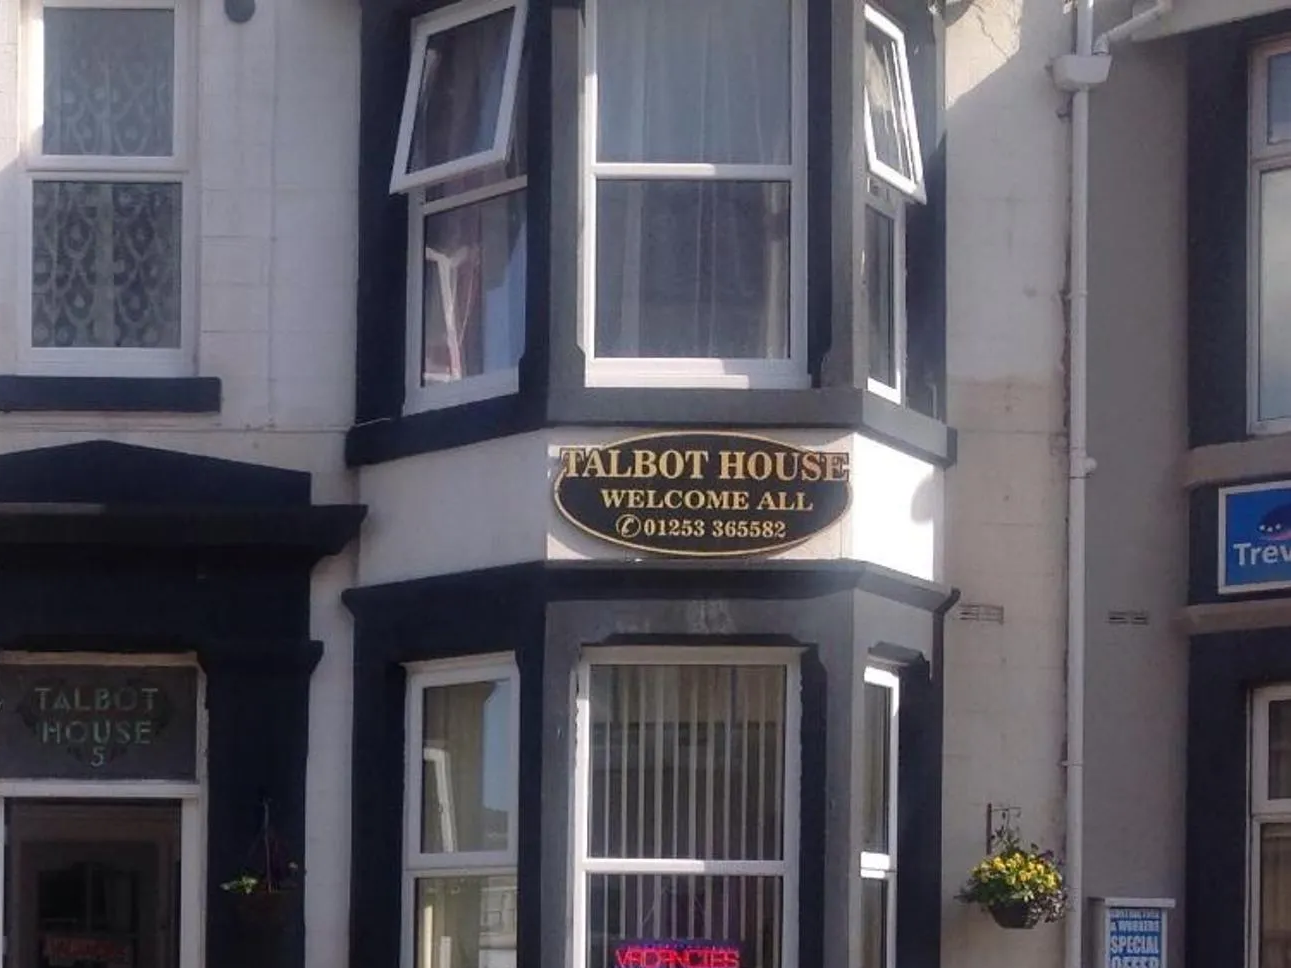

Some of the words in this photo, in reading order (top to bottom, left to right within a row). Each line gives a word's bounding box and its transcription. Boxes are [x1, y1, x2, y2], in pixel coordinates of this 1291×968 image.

[561, 447, 708, 480] TALBOT
[718, 450, 849, 481] HOUSE
[601, 489, 749, 510] WELCOME
[756, 491, 813, 511] ALL
[644, 519, 705, 536] 01253
[712, 519, 786, 538] 365582
[34, 687, 158, 711] TALBOT
[42, 720, 151, 744] HOUSE
[90, 747, 104, 767] 5
[1110, 935, 1159, 954] SPECIAL
